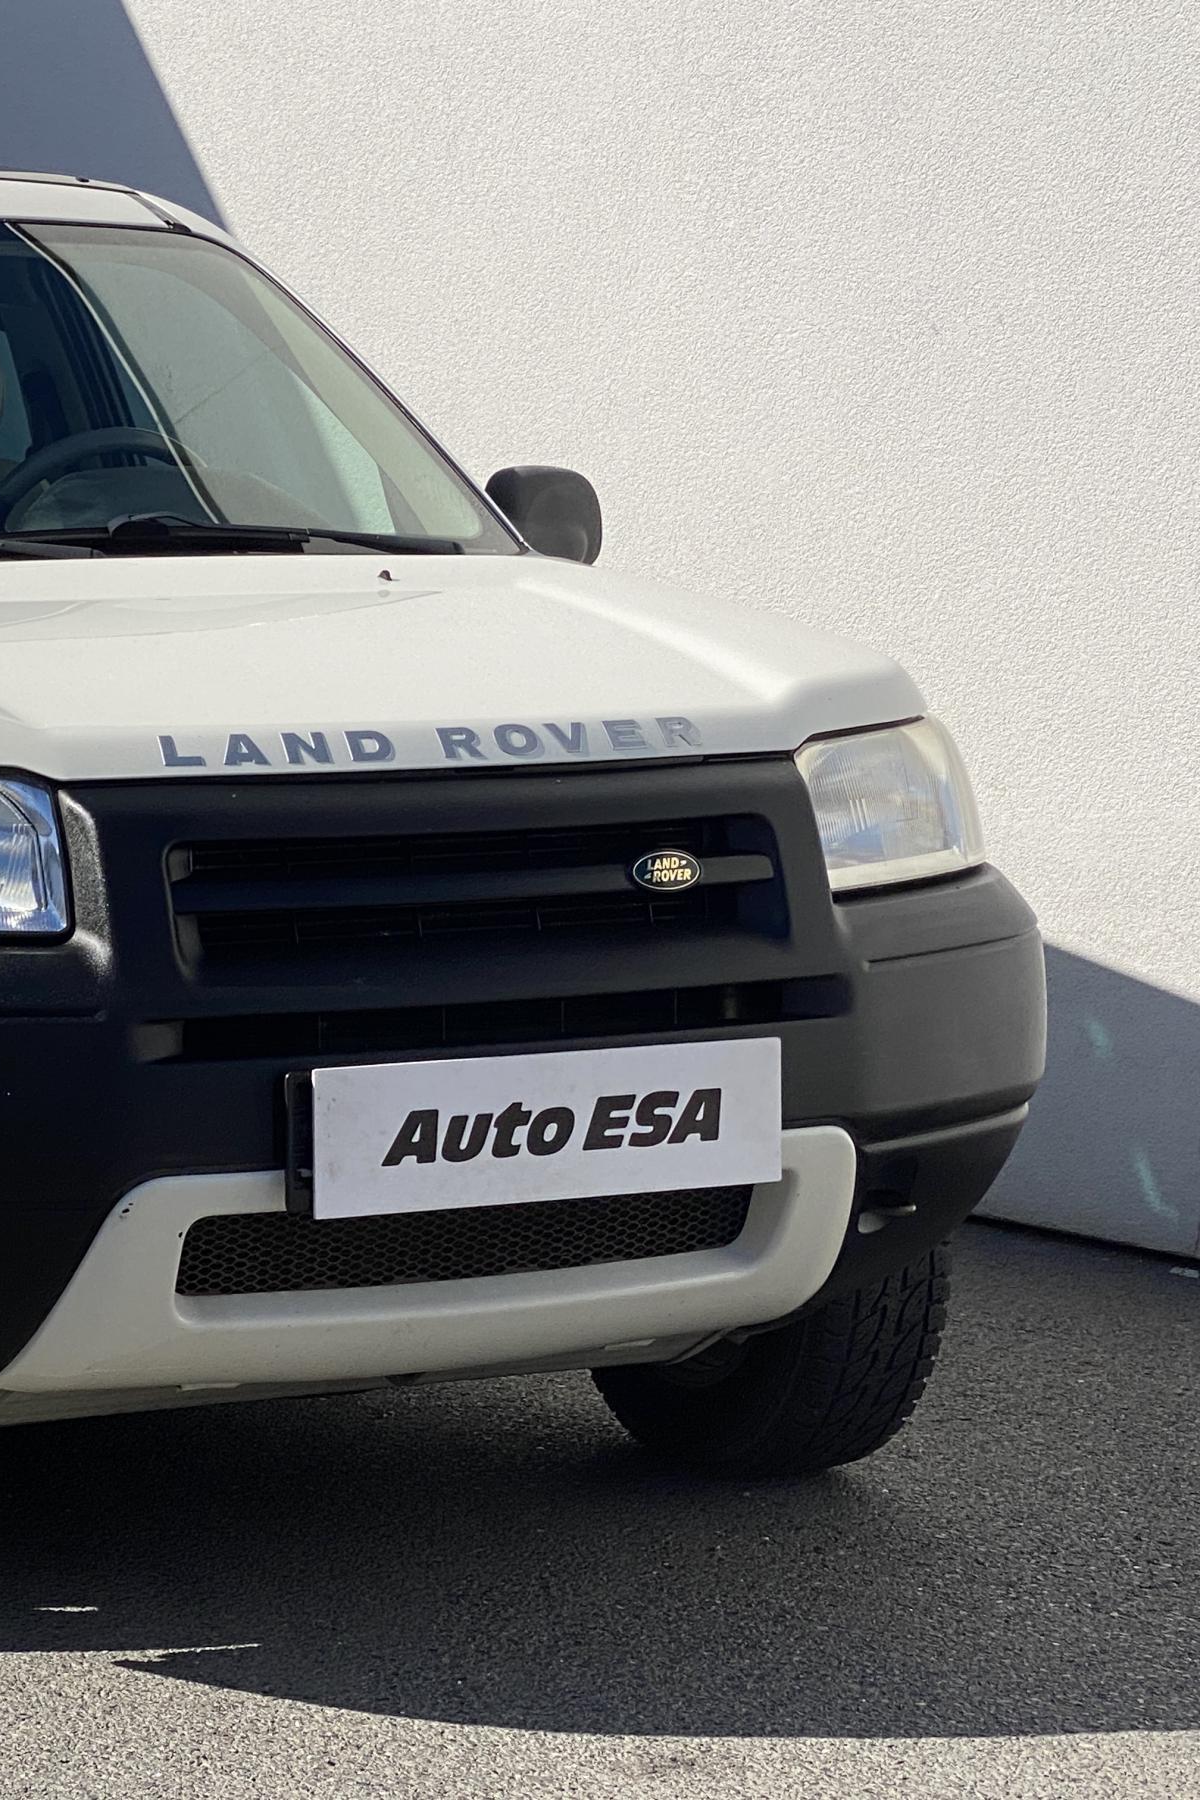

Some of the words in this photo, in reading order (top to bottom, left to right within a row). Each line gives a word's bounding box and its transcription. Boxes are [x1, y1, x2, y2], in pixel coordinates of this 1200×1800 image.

[156, 730, 394, 767] LAND
[434, 716, 702, 760] ROVER
[647, 857, 680, 871] LAND
[653, 869, 692, 883] ROVER
[381, 1102, 576, 1167] Auto
[582, 1087, 722, 1151] ESA
